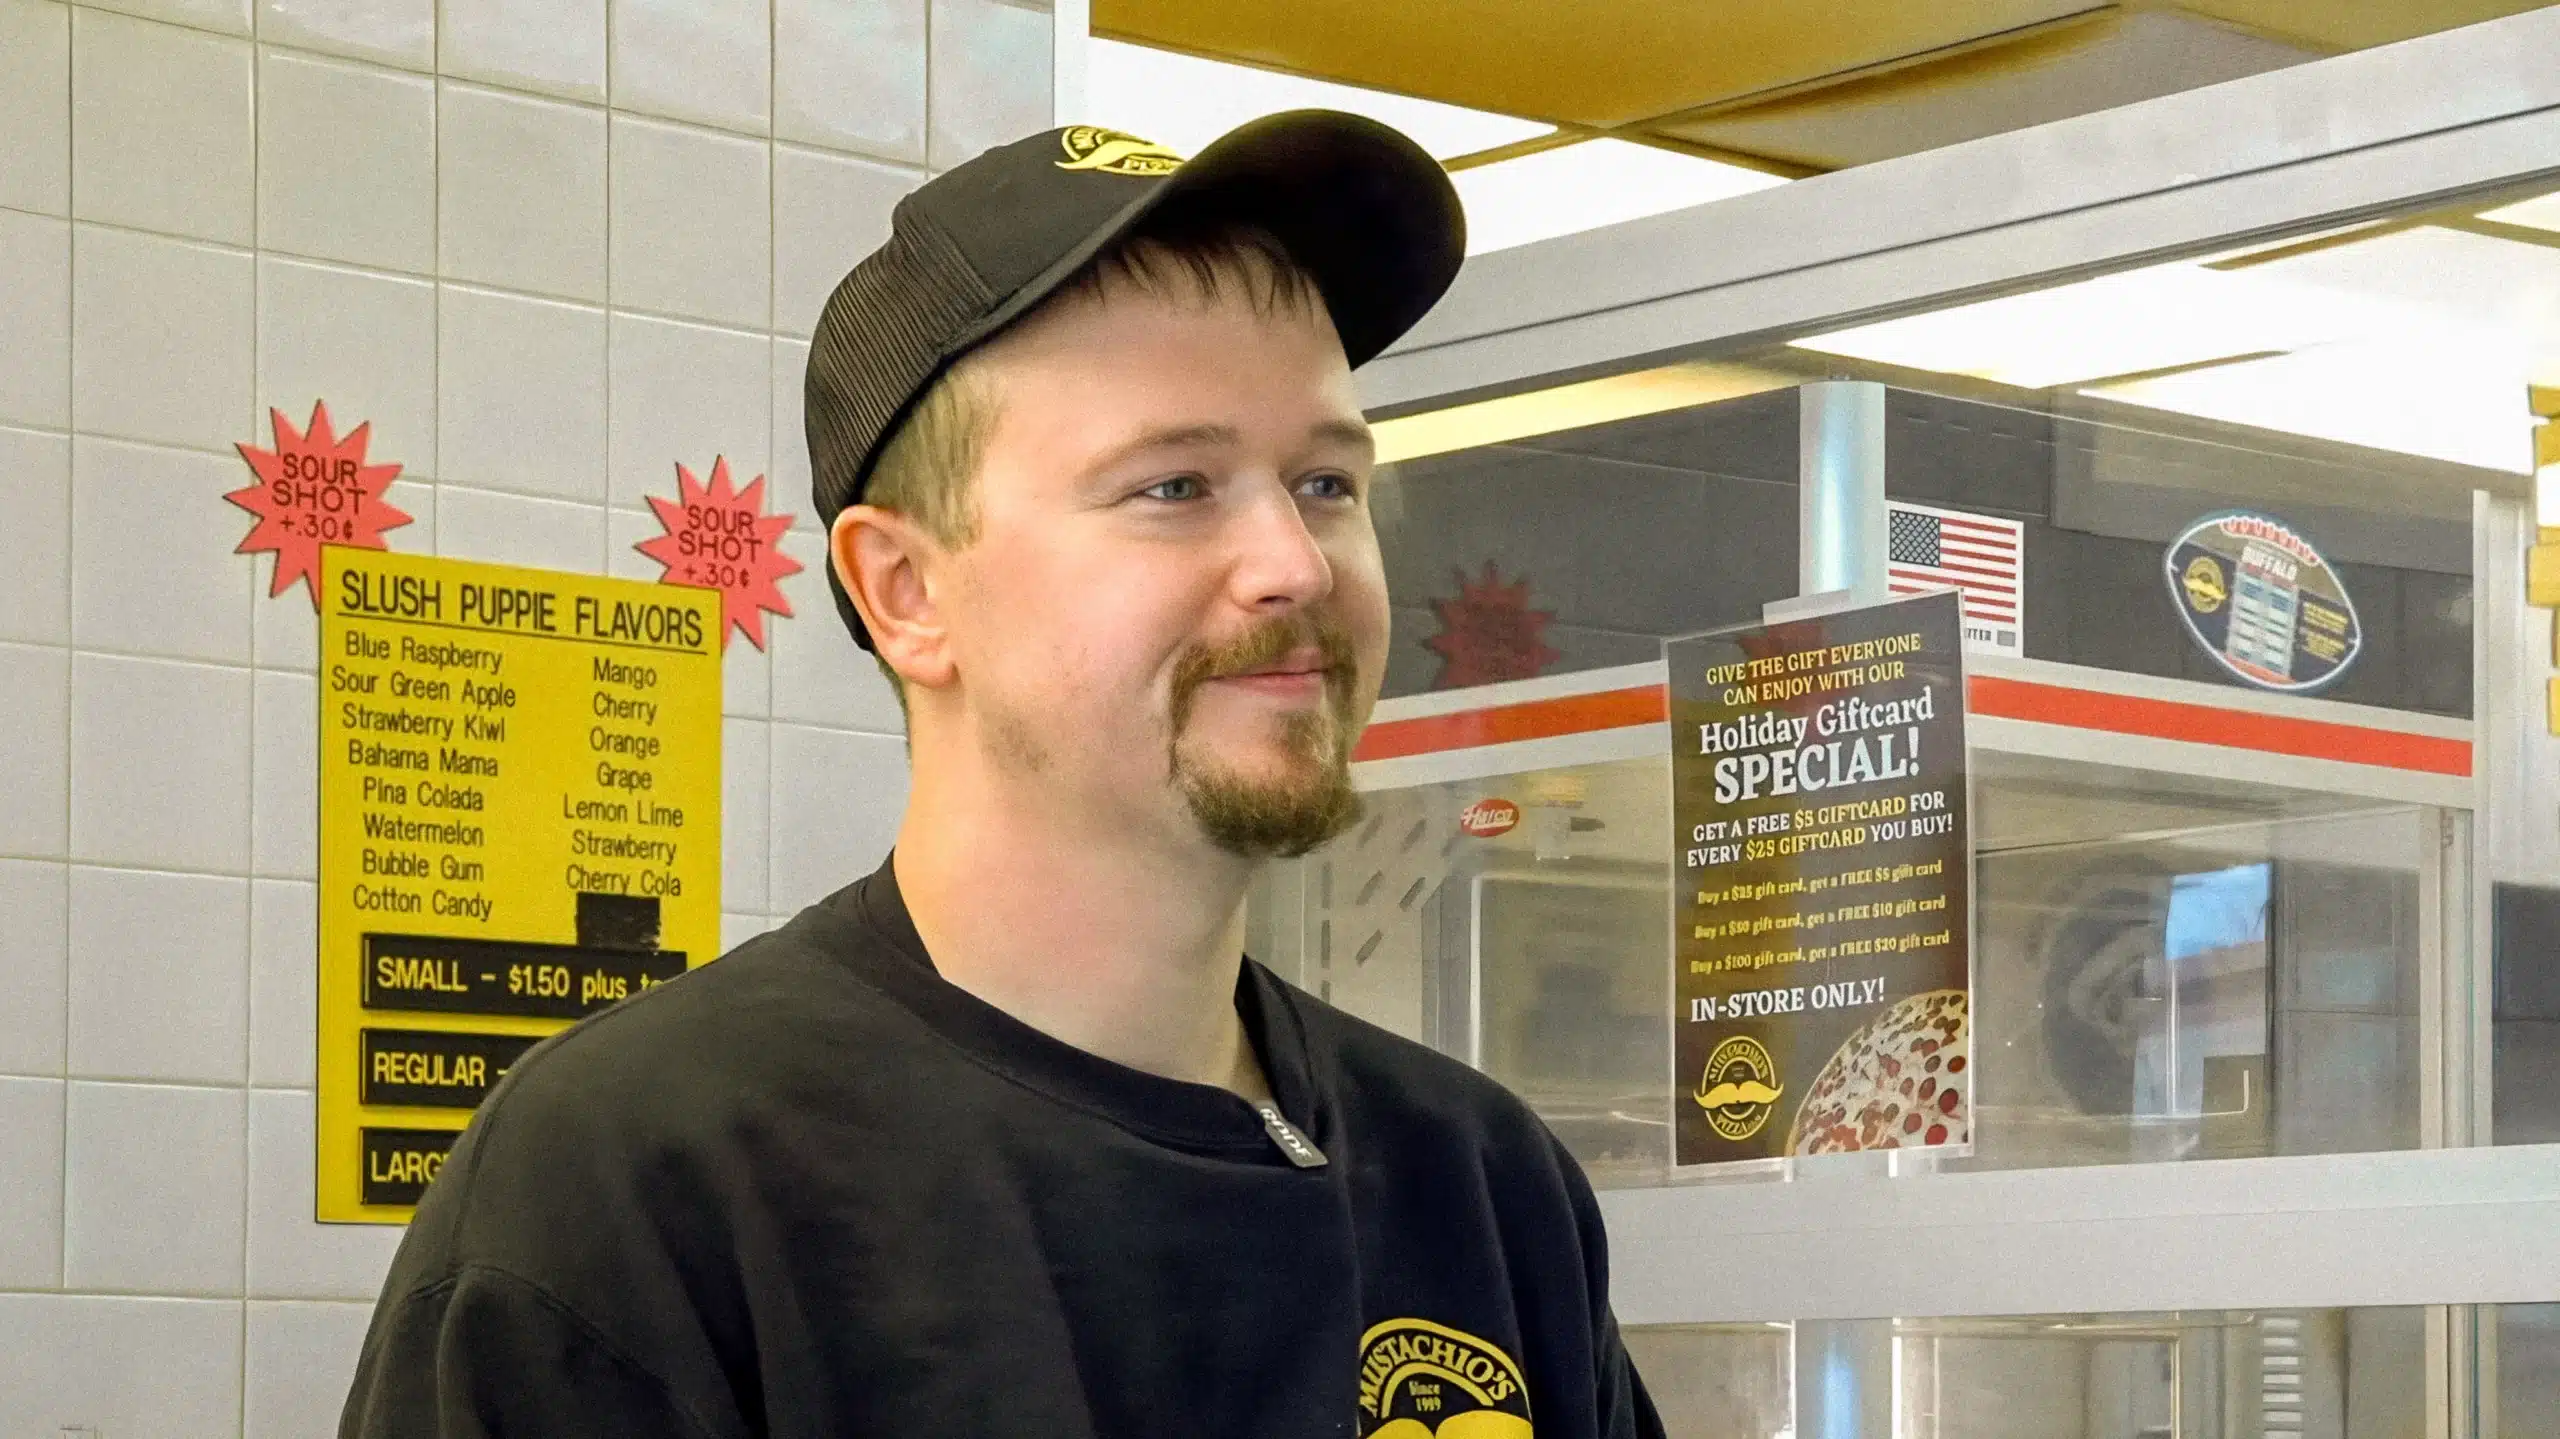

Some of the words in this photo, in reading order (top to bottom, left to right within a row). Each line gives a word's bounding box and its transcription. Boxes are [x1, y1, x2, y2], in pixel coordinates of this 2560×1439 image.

[282, 452, 358, 486] SOUR
[271, 478, 368, 515] SHOT
[687, 504, 755, 535] SOUR
[677, 529, 763, 564] SHOT
[341, 568, 441, 619] SLUSH
[460, 583, 557, 633] PUPPIE
[575, 595, 703, 647] FLAVORS
[345, 630, 391, 659] Blue
[402, 636, 503, 676] Raspberry
[1706, 662, 1746, 686] GIVE
[1748, 656, 1784, 679] THE
[1787, 649, 1827, 672] GIFT
[1830, 633, 1922, 665] EVERYONE
[331, 665, 380, 693] Sour
[391, 671, 450, 702] Green
[461, 679, 516, 711] Apple
[593, 656, 658, 690] Mango
[1723, 685, 1758, 707] CAN
[1761, 675, 1815, 702] ENJOY
[1817, 666, 1865, 692] WITH
[1868, 660, 1905, 682] OUR
[342, 701, 454, 742] Strawberry
[593, 691, 658, 727] Cherry
[1700, 711, 1810, 754] Holiday
[1816, 685, 1935, 737] Giftcard
[348, 738, 430, 771] Bahama
[439, 747, 499, 777] Mama
[590, 725, 661, 760] Orange
[597, 761, 653, 795] Grape
[1714, 726, 1920, 805] SPECIAL!
[363, 776, 407, 805] Pina
[417, 780, 485, 812] Colada
[563, 792, 629, 823] Lemon
[637, 800, 685, 828] Lime
[362, 812, 486, 848] Watermelon
[1693, 822, 1728, 842] GET
[1730, 821, 1744, 838] A
[1747, 813, 1790, 835] FREE
[1818, 796, 1906, 825] GIFTCARD
[1910, 791, 1946, 812] FOR
[571, 828, 678, 867] Strawberry
[1687, 843, 1742, 868] EVERY
[1779, 827, 1866, 855] GIFTCARD
[1870, 821, 1907, 843] YOU
[1911, 813, 1954, 837] BUY!
[361, 848, 431, 878] Bubble
[440, 854, 486, 882] Gum
[565, 863, 632, 895] Cherry
[640, 869, 683, 897] Cola
[1698, 891, 1720, 906] Buy
[1755, 881, 1776, 901] gift
[1841, 869, 1873, 886] FREE
[1892, 864, 1914, 883] gift
[1916, 860, 1942, 876] card
[352, 884, 422, 914] Cotton
[432, 889, 494, 923] Candy
[1695, 925, 1717, 940] Buy
[1752, 916, 1773, 936] gift
[1807, 912, 1825, 929] get
[1838, 904, 1870, 922] FREE
[1872, 902, 1893, 919] $10
[1895, 899, 1917, 918] gift
[1919, 894, 1946, 911] card
[1725, 953, 1752, 971] $100
[1754, 950, 1775, 970] gift
[1840, 940, 1872, 956] FREE
[1898, 932, 1920, 953] gift
[1923, 928, 1950, 946] card
[376, 956, 469, 993] SMALL
[507, 964, 571, 998] $1.50
[581, 967, 628, 1006] plus
[1691, 986, 1805, 1023] IN-STORE
[1811, 976, 1885, 1010] ONLY!
[372, 1051, 486, 1088] REGULAR
[371, 1150, 451, 1184] LARG
[1359, 1335, 1518, 1419] MUSTACHIO'S
